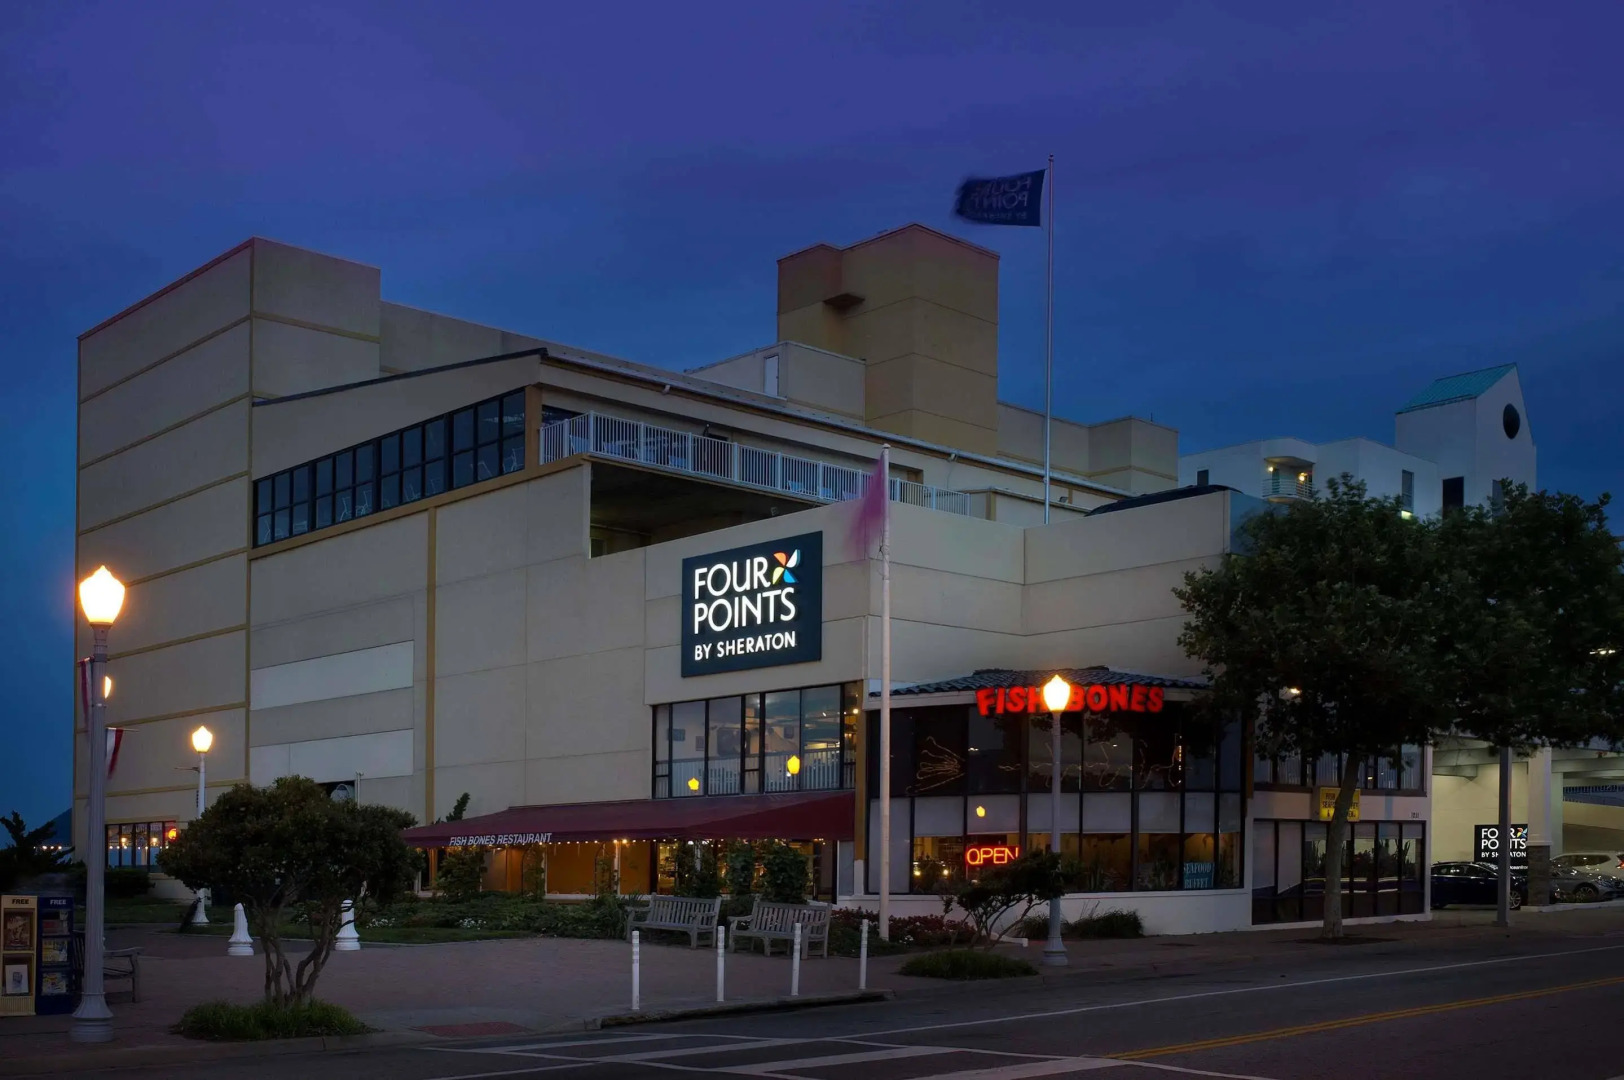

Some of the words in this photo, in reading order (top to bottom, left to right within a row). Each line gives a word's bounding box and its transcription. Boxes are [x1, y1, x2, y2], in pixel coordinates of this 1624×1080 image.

[694, 556, 771, 600] FOUR
[694, 587, 796, 634] POINTS
[694, 643, 713, 661] BY
[716, 630, 796, 658] SHERATON
[975, 685, 1048, 716] FISH
[1067, 682, 1165, 713] BONES
[449, 836, 468, 847] FISH
[468, 834, 496, 846] BONES
[497, 832, 552, 845] RESTAURANT
[1481, 828, 1516, 839] FOR
[1481, 838, 1527, 850] POTS
[966, 847, 1019, 865] OPEN
